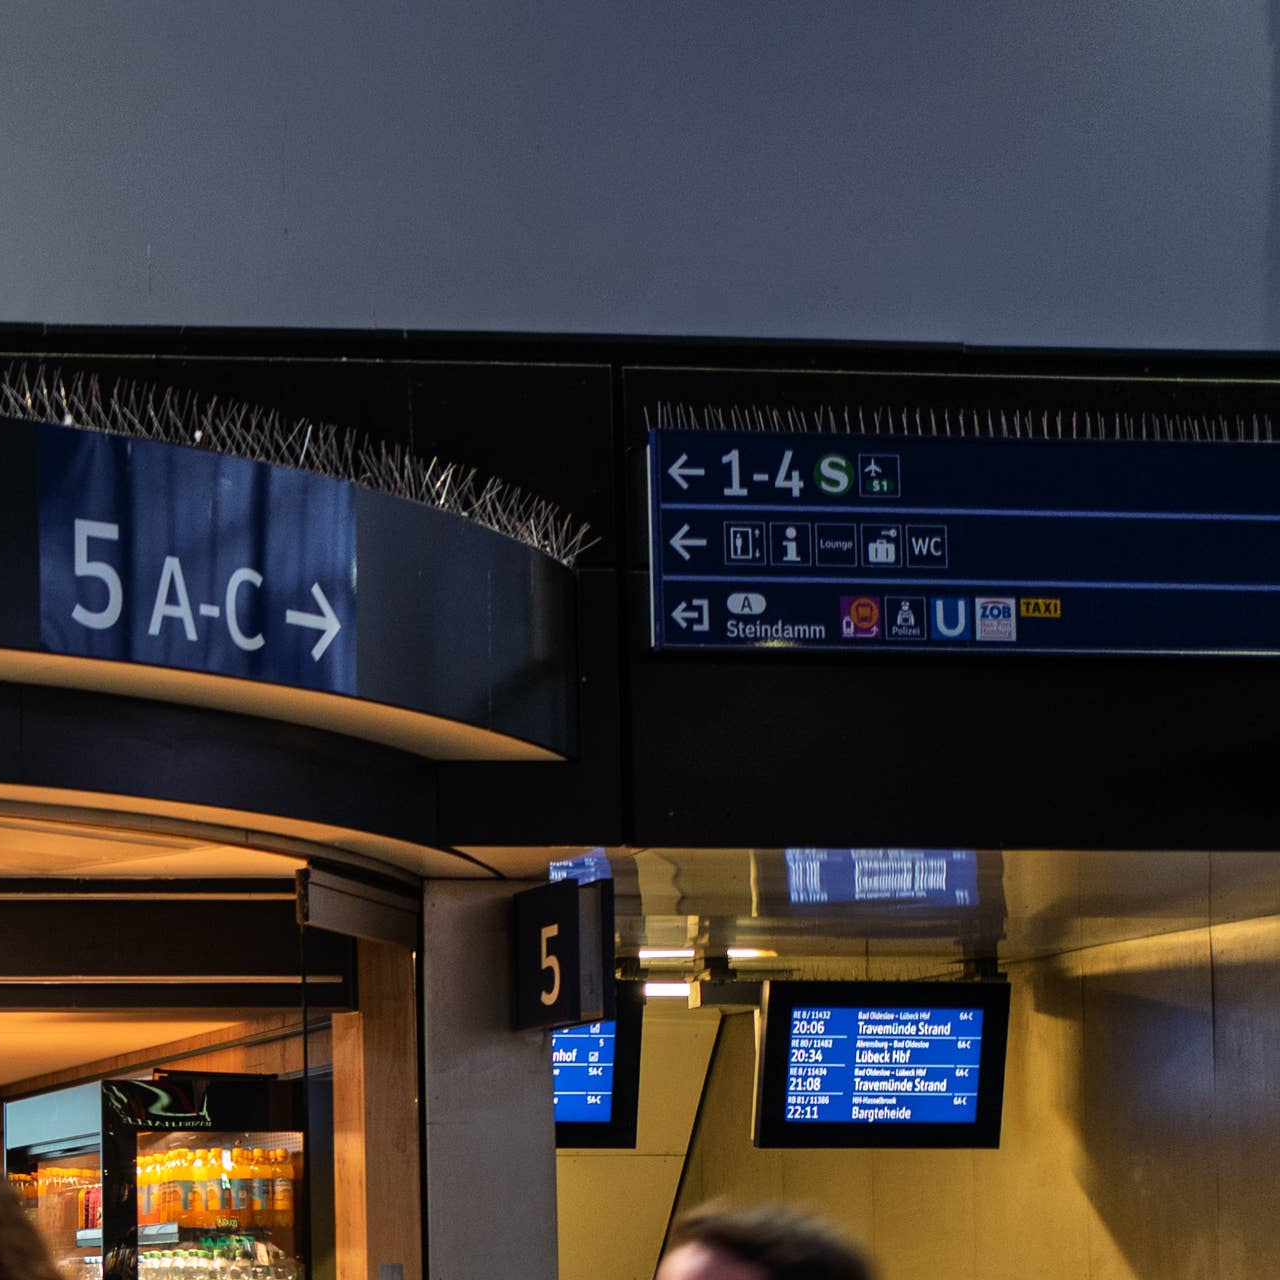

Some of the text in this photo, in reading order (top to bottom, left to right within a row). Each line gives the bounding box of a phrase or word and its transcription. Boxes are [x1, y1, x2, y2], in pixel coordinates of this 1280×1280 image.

[721, 449, 849, 498] 1-4 S
[819, 538, 854, 550] Lounge
[911, 537, 943, 556] WC
[71, 518, 266, 652] 5 A-C
[741, 596, 754, 612] A
[1022, 601, 1061, 615] TAXI
[935, 598, 966, 637] U
[980, 604, 1013, 620] ZOB
[726, 620, 826, 640] Steindamm
[891, 625, 921, 637] Polizei
[540, 923, 561, 1007] 5
[793, 1021, 825, 1034] 20:06
[858, 1022, 951, 1035] Travemünde Strand
[791, 1050, 823, 1062] 20:34
[855, 1050, 911, 1063] Lübeck Hbf
[790, 1078, 821, 1091] 21:08
[854, 1079, 948, 1092] Travemünde Strand
[787, 1106, 818, 1119] 22:11
[851, 1107, 912, 1122] Bargteheide
